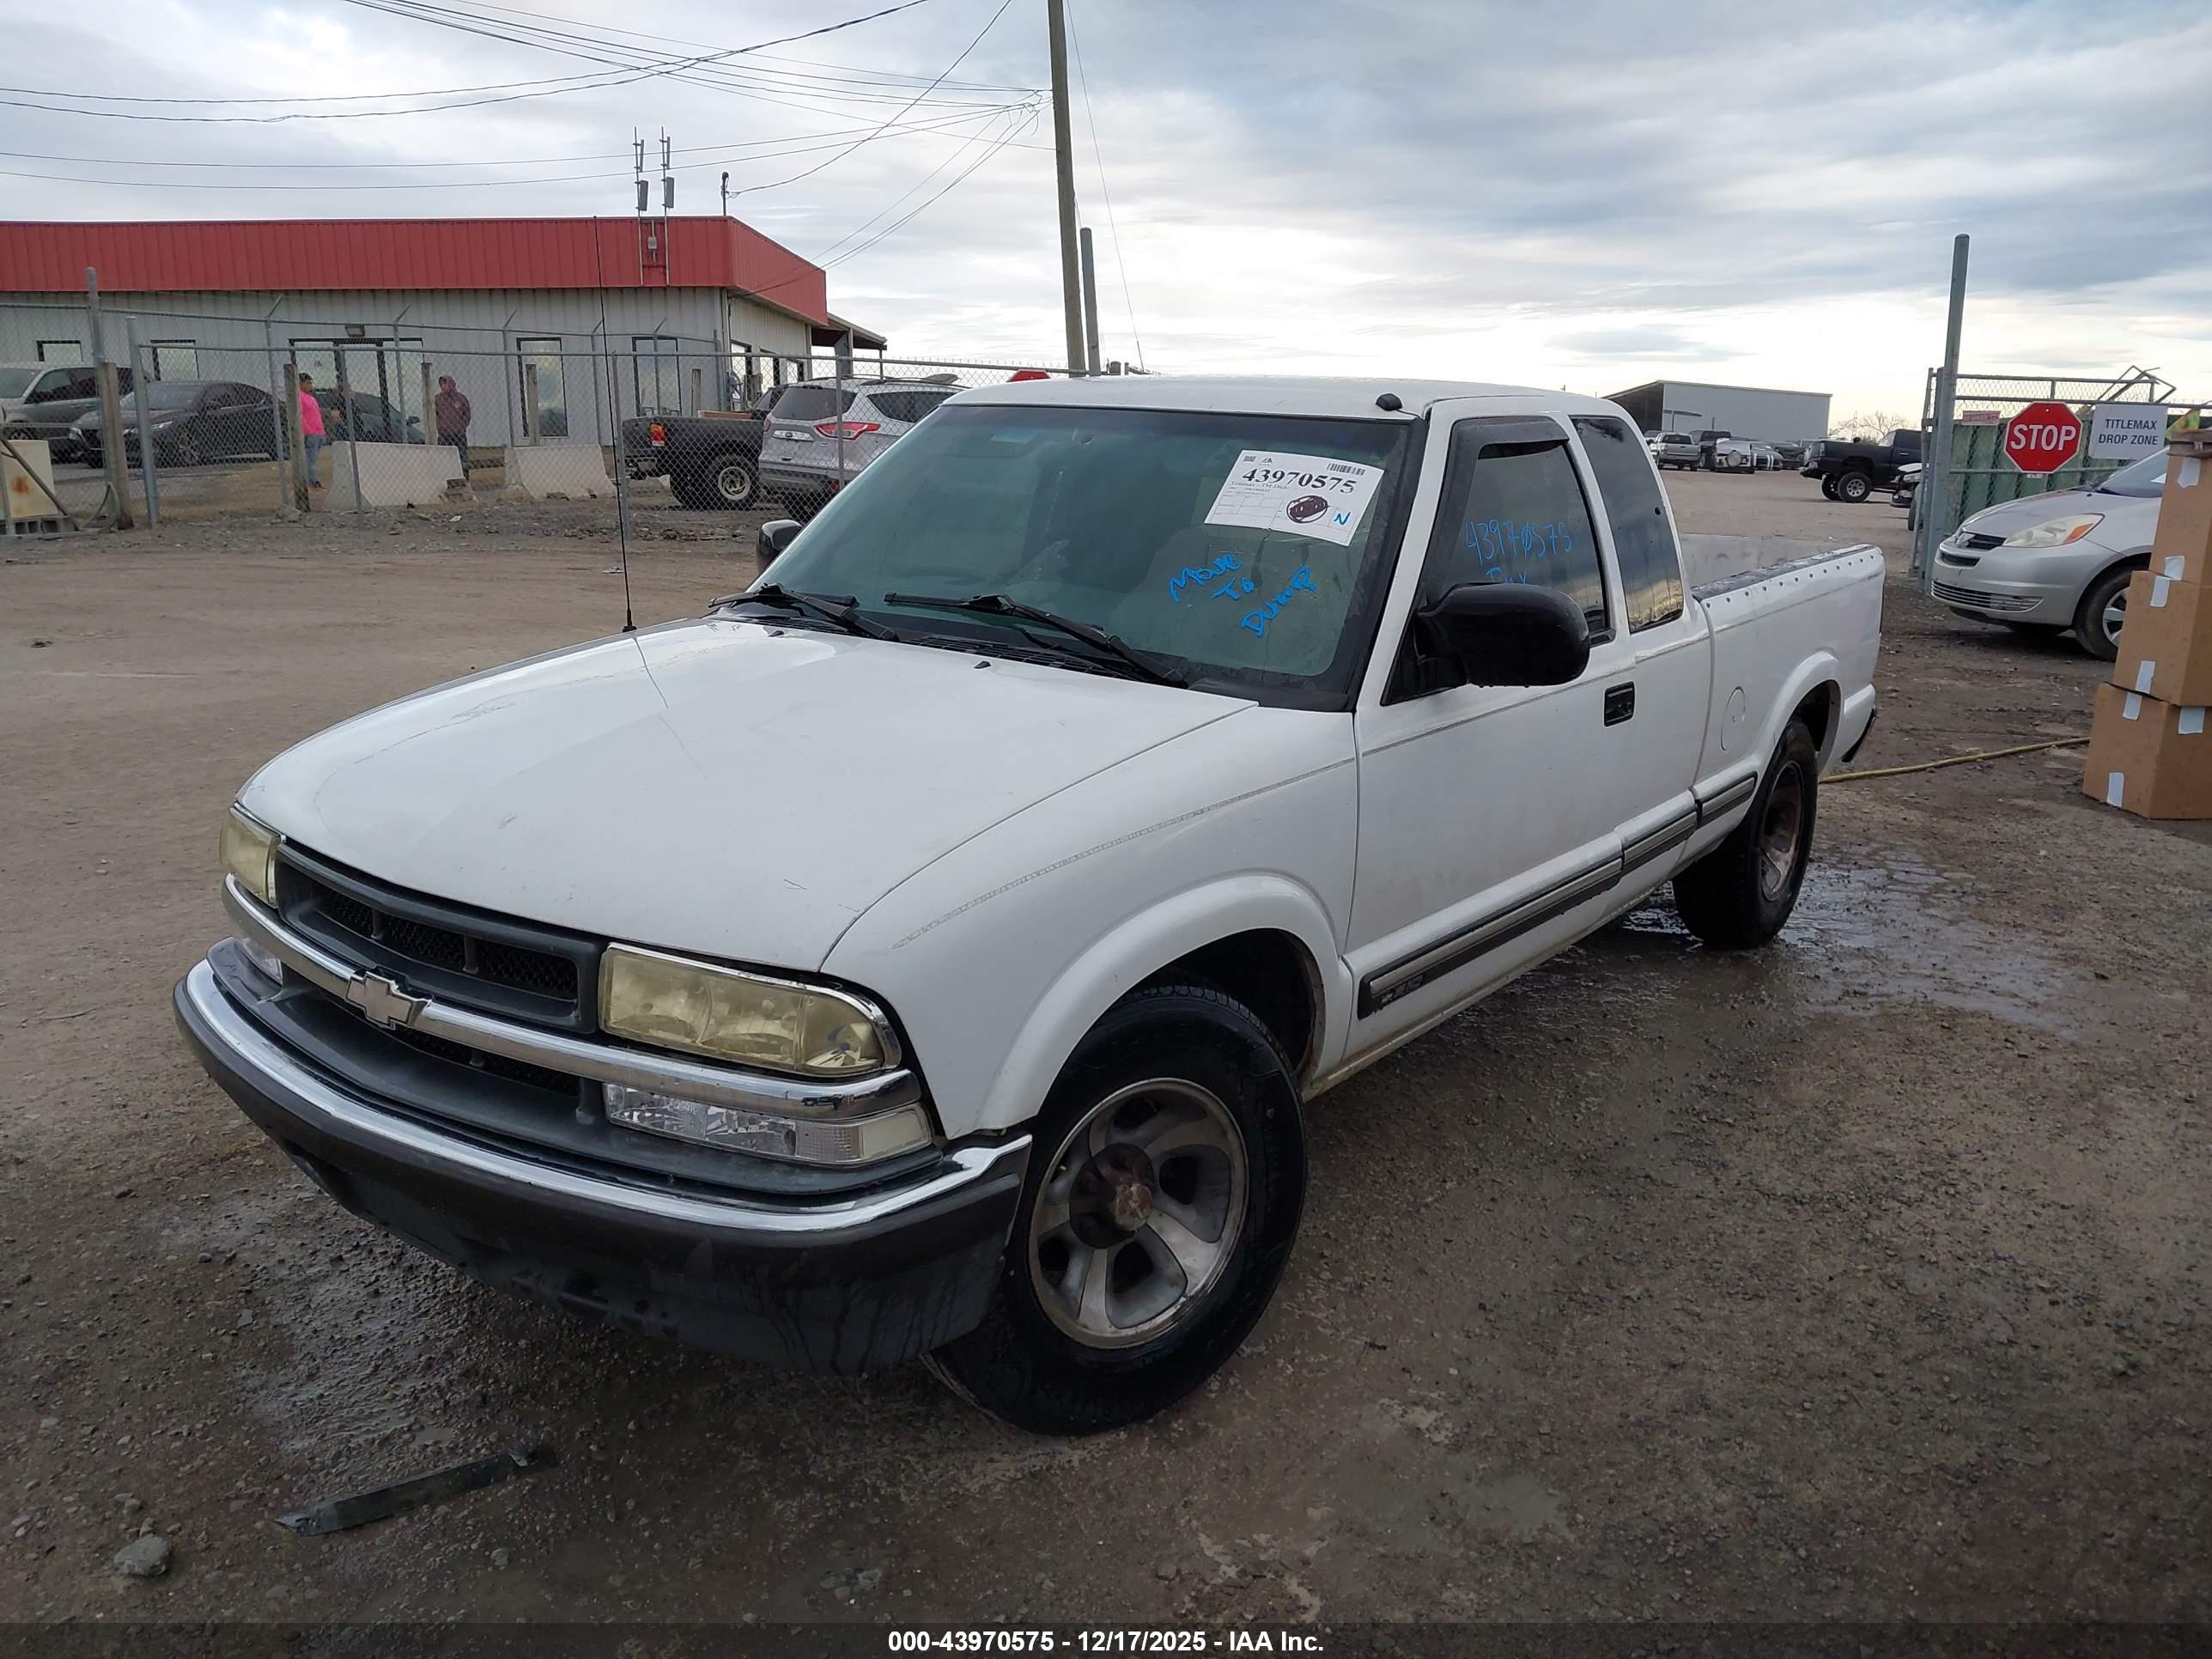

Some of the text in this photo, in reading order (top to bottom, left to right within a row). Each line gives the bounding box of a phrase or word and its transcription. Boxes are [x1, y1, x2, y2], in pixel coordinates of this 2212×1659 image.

[2106, 418, 2157, 430] TITLEMAX
[2010, 424, 2076, 451] STOP
[2099, 434, 2158, 446] DROP ZONE
[1243, 468, 1358, 494] 43970575
[1334, 512, 1351, 525] N
[1465, 520, 1571, 565] 43970575
